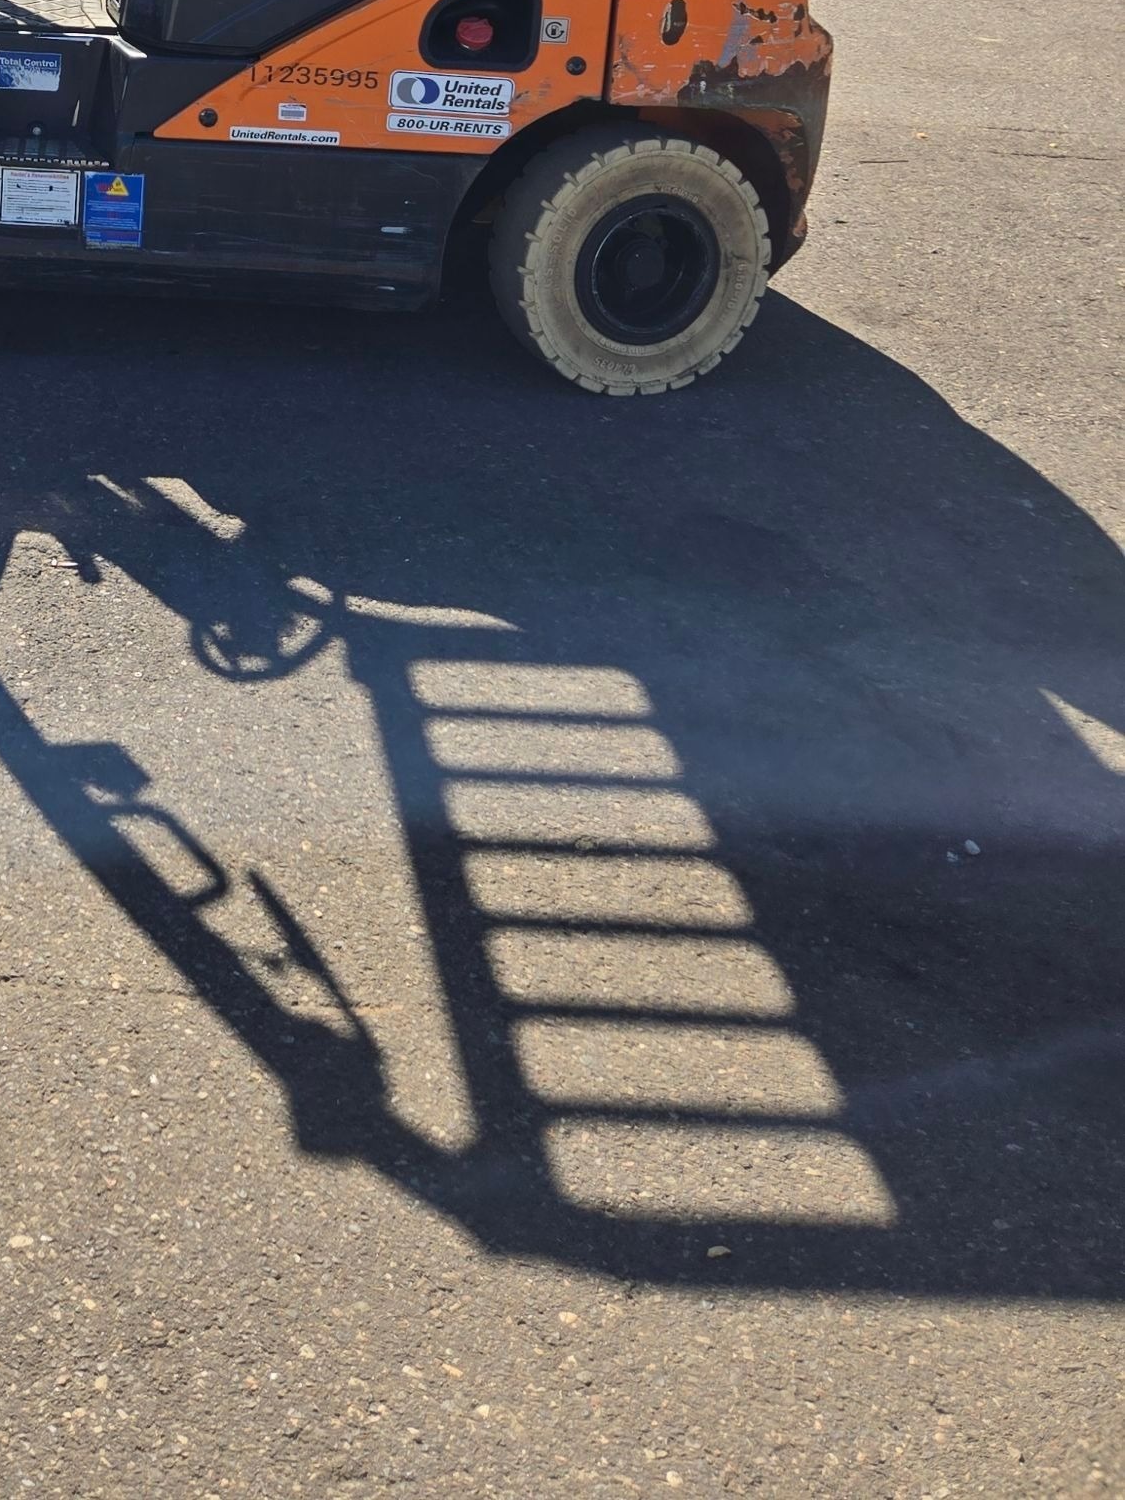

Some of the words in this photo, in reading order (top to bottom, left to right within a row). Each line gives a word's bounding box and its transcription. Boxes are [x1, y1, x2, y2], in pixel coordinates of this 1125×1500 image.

[0, 56, 22, 67] Total
[23, 58, 57, 68] Control
[250, 65, 379, 89] 11235995
[444, 80, 503, 96] United
[441, 94, 506, 111] Rentals
[396, 118, 503, 135] 800-UR-RENTS
[231, 129, 338, 143] UnitedRentals.com
